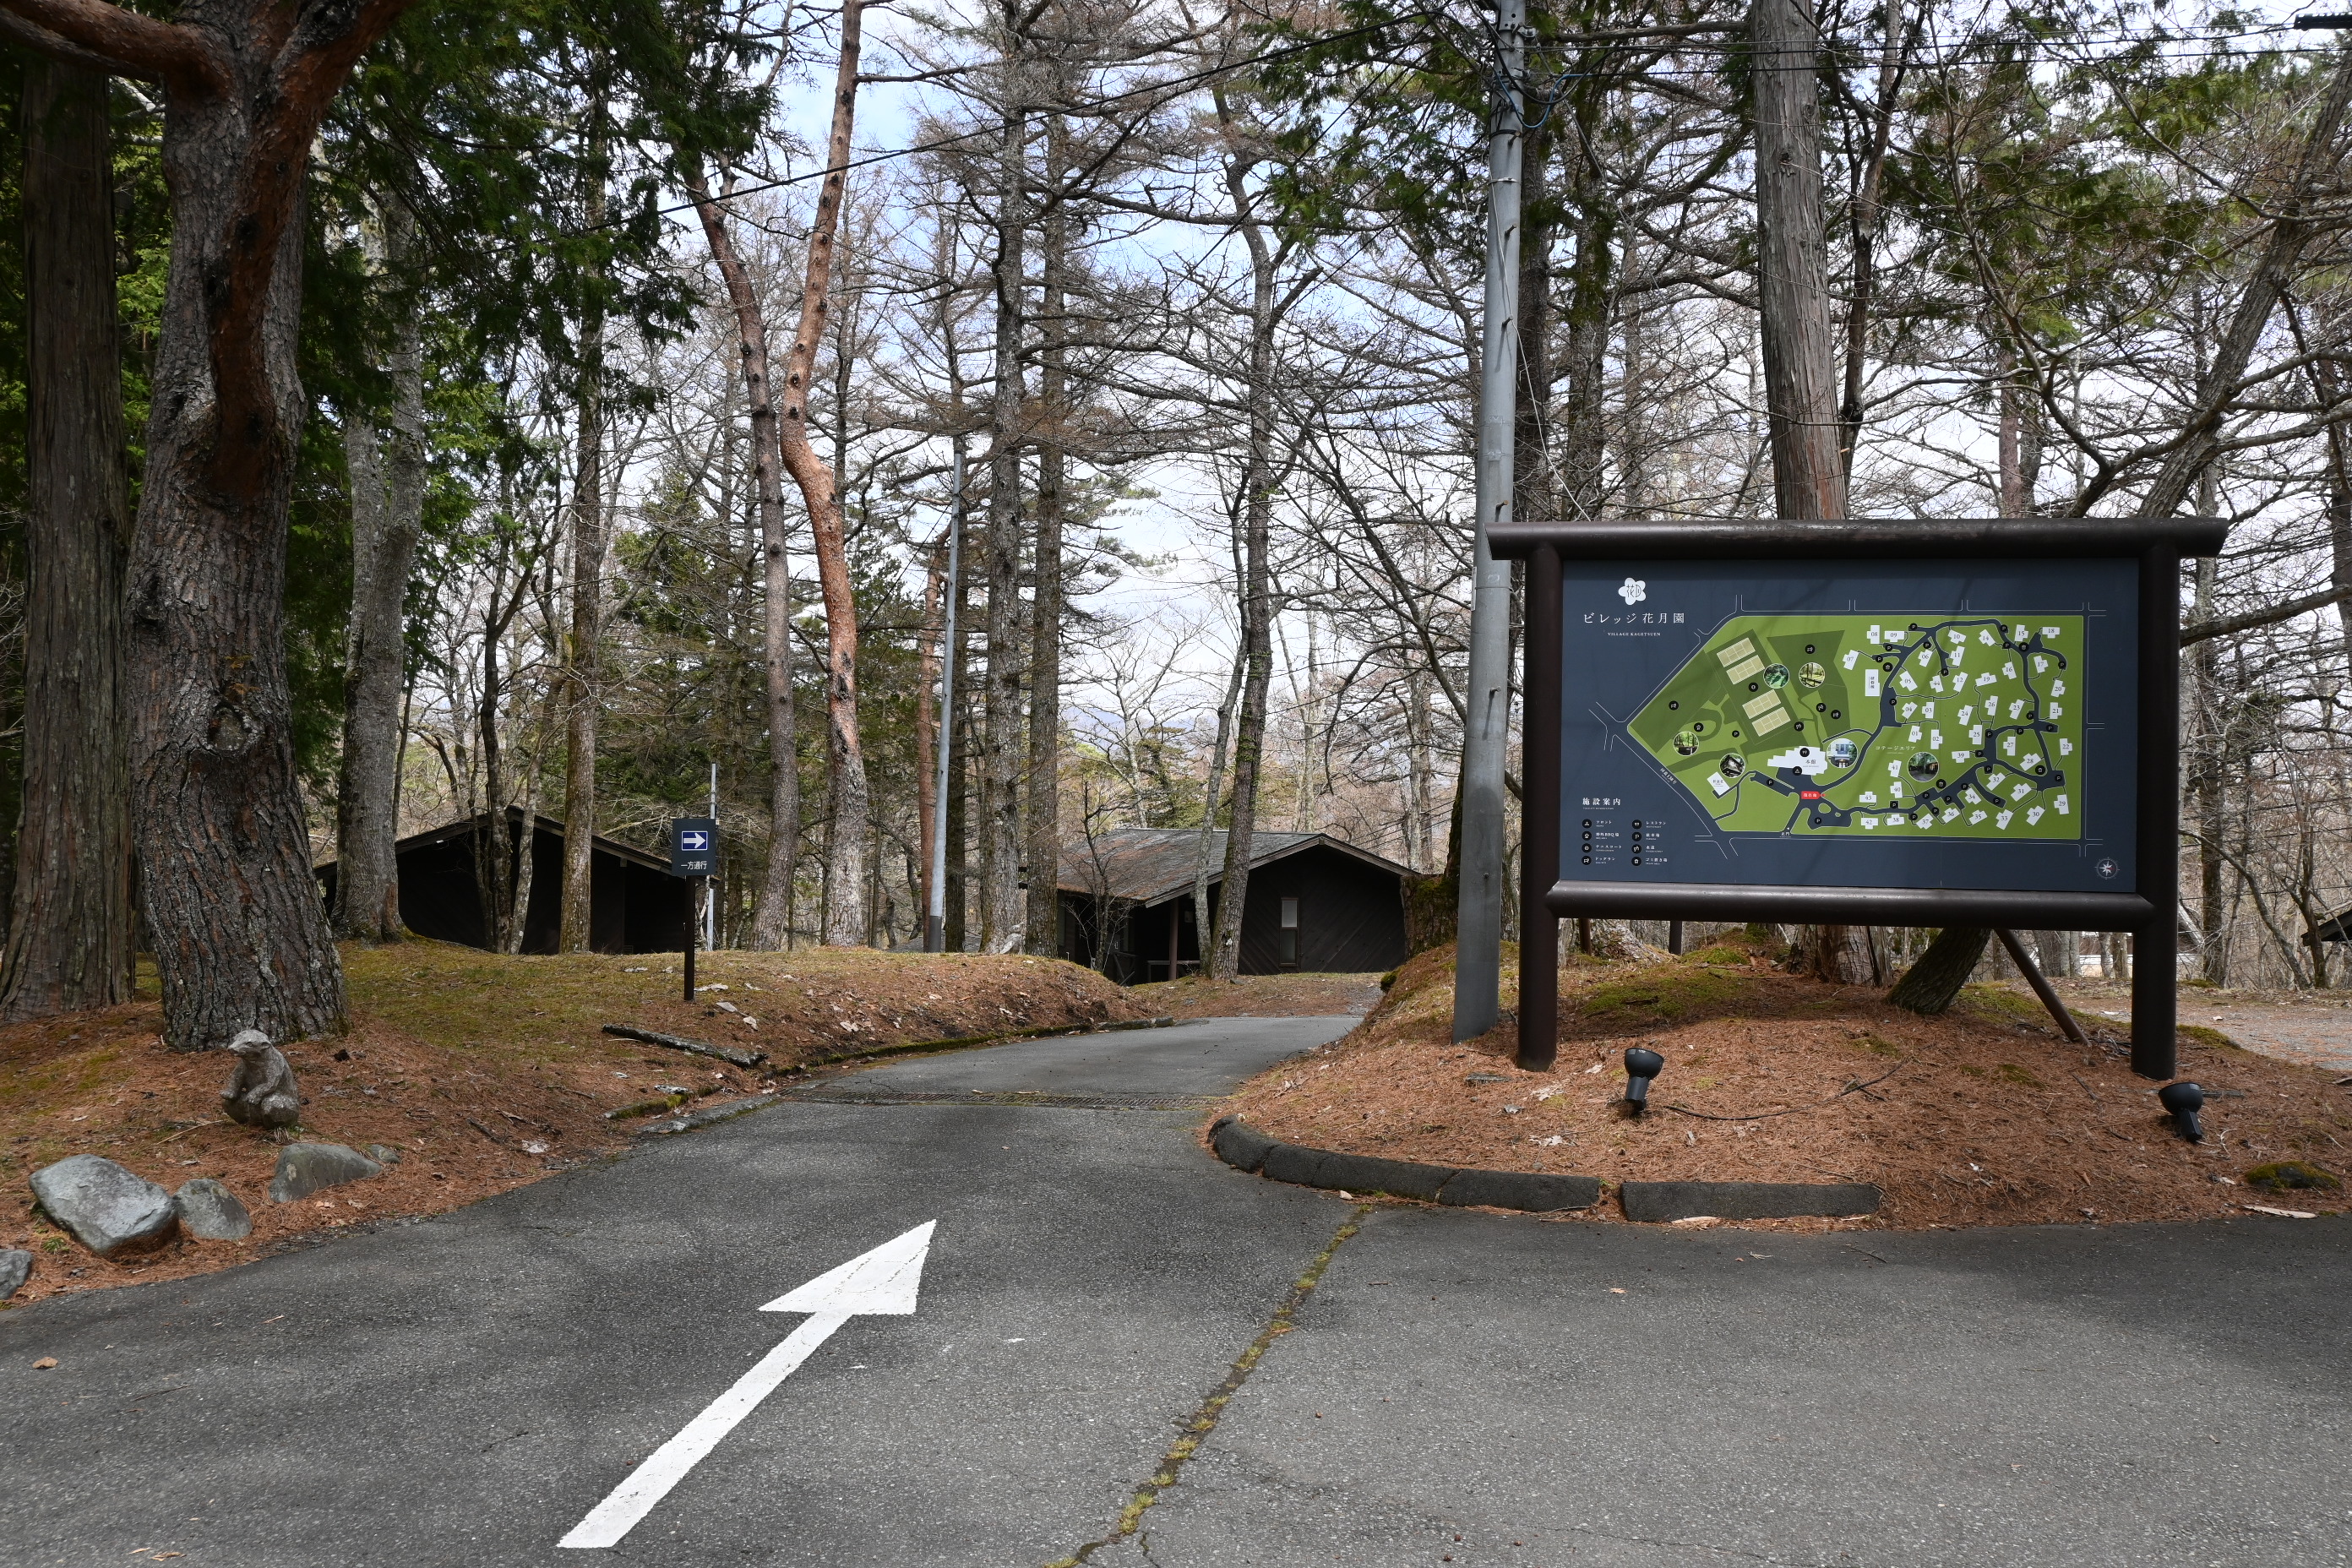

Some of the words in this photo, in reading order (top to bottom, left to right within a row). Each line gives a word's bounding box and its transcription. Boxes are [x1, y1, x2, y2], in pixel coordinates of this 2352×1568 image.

[1583, 612, 1685, 624] ビレッジ花月園
[681, 861, 707, 869] 一方通行
